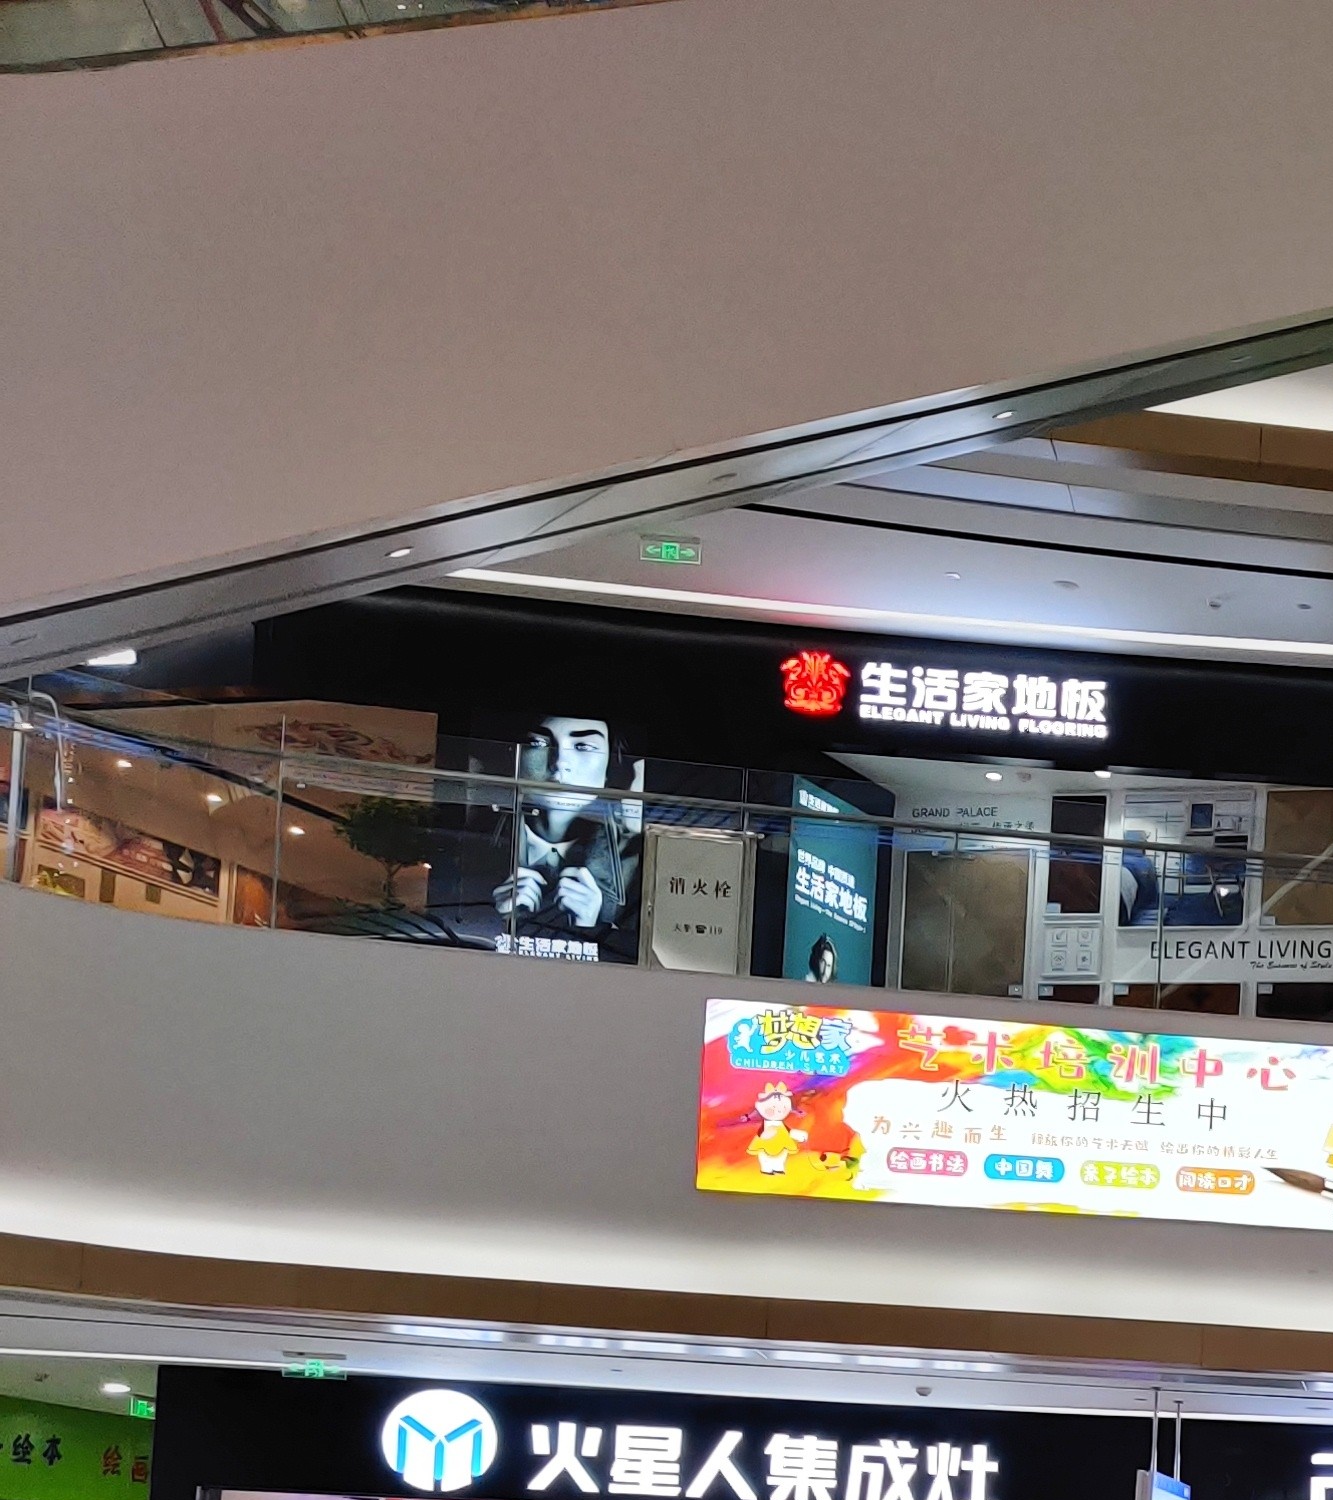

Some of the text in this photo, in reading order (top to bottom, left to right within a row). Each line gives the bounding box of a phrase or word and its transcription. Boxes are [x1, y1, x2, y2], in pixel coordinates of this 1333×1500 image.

[859, 661, 1107, 722] 生活家地板
[950, 712, 1011, 731] LIVING
[912, 806, 999, 818] GRAND PALACE
[669, 876, 732, 899] 消火栓
[795, 866, 868, 922] 生活家地板
[1150, 940, 1333, 960] ELEGANT LIVING
[757, 1010, 854, 1055] 梦想家
[897, 1023, 1297, 1092] 艺术培训中心
[937, 1078, 1227, 1132] 火热招生中
[871, 1115, 1008, 1146] 为兴趣而生
[889, 1150, 966, 1174] 绘画书法
[994, 1158, 1055, 1180] 中国舞
[1179, 1170, 1253, 1192] 阅读口才
[0, 1433, 62, 1466] 绘本
